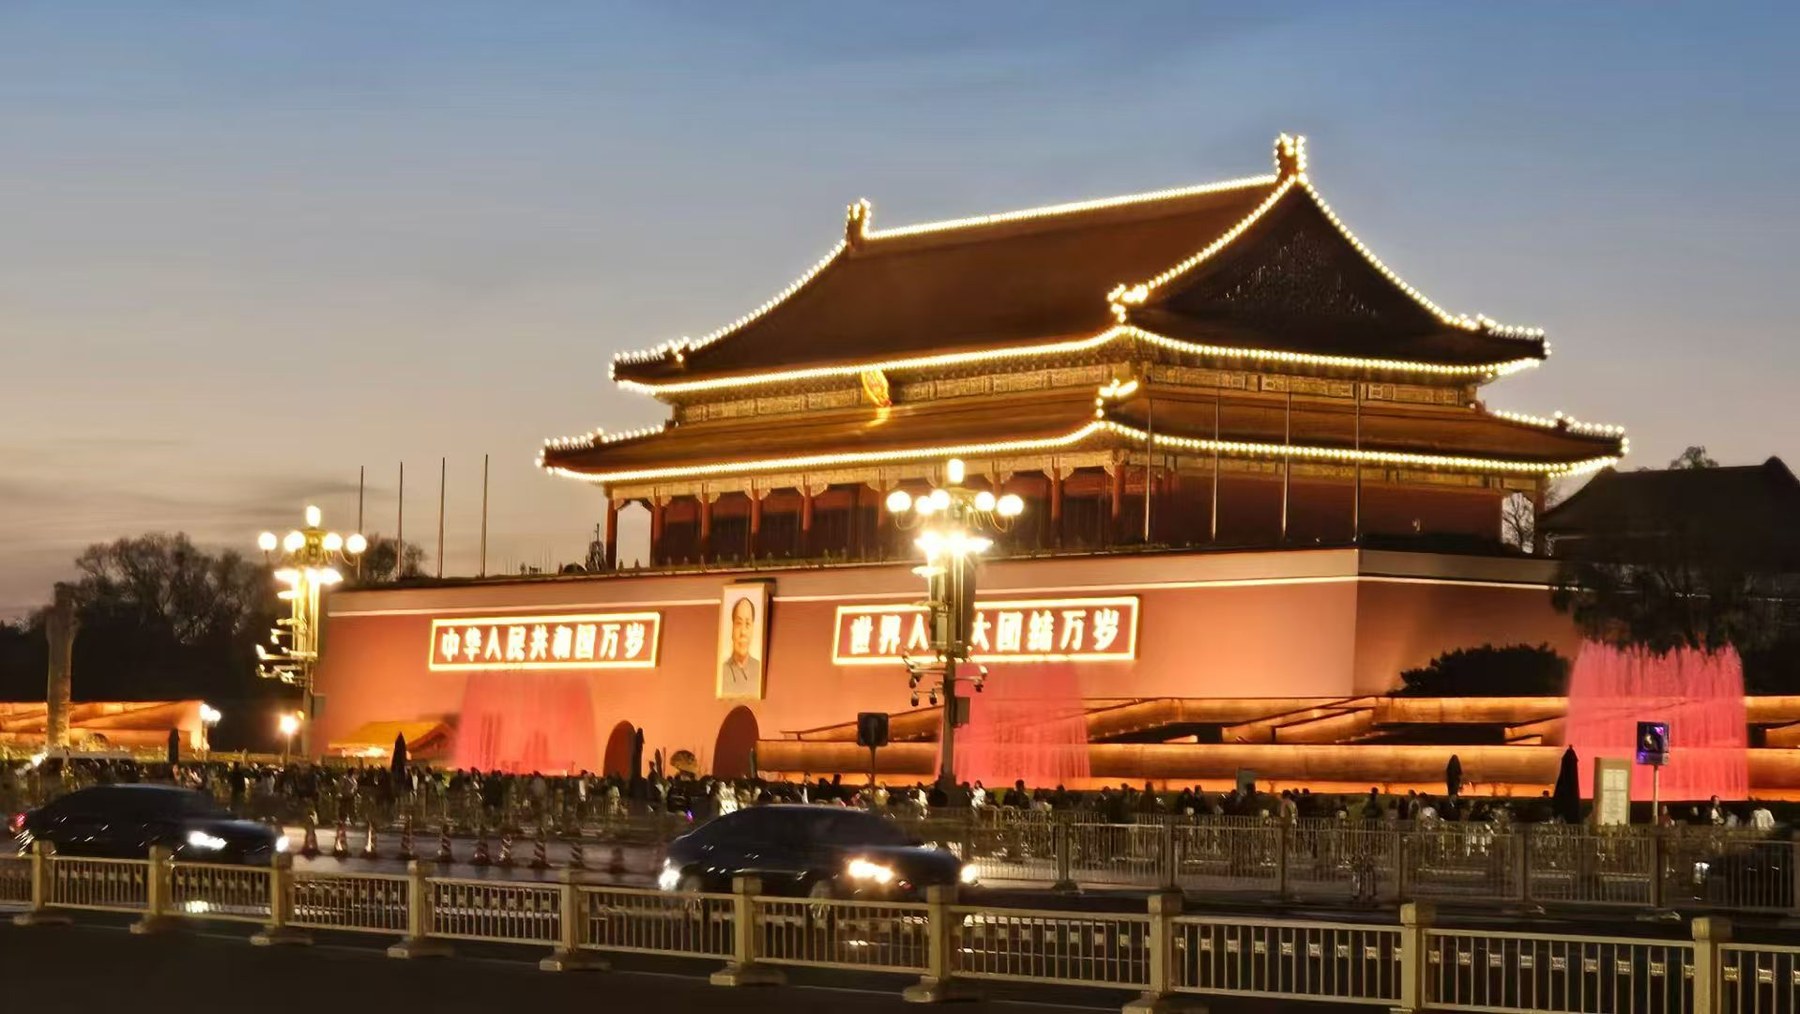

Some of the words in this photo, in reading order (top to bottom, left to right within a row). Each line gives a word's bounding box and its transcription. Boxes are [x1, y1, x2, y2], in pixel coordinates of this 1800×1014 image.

[442, 622, 645, 661] 中华人民共和国万岁
[851, 608, 1119, 654] 世界人大团结万岁
